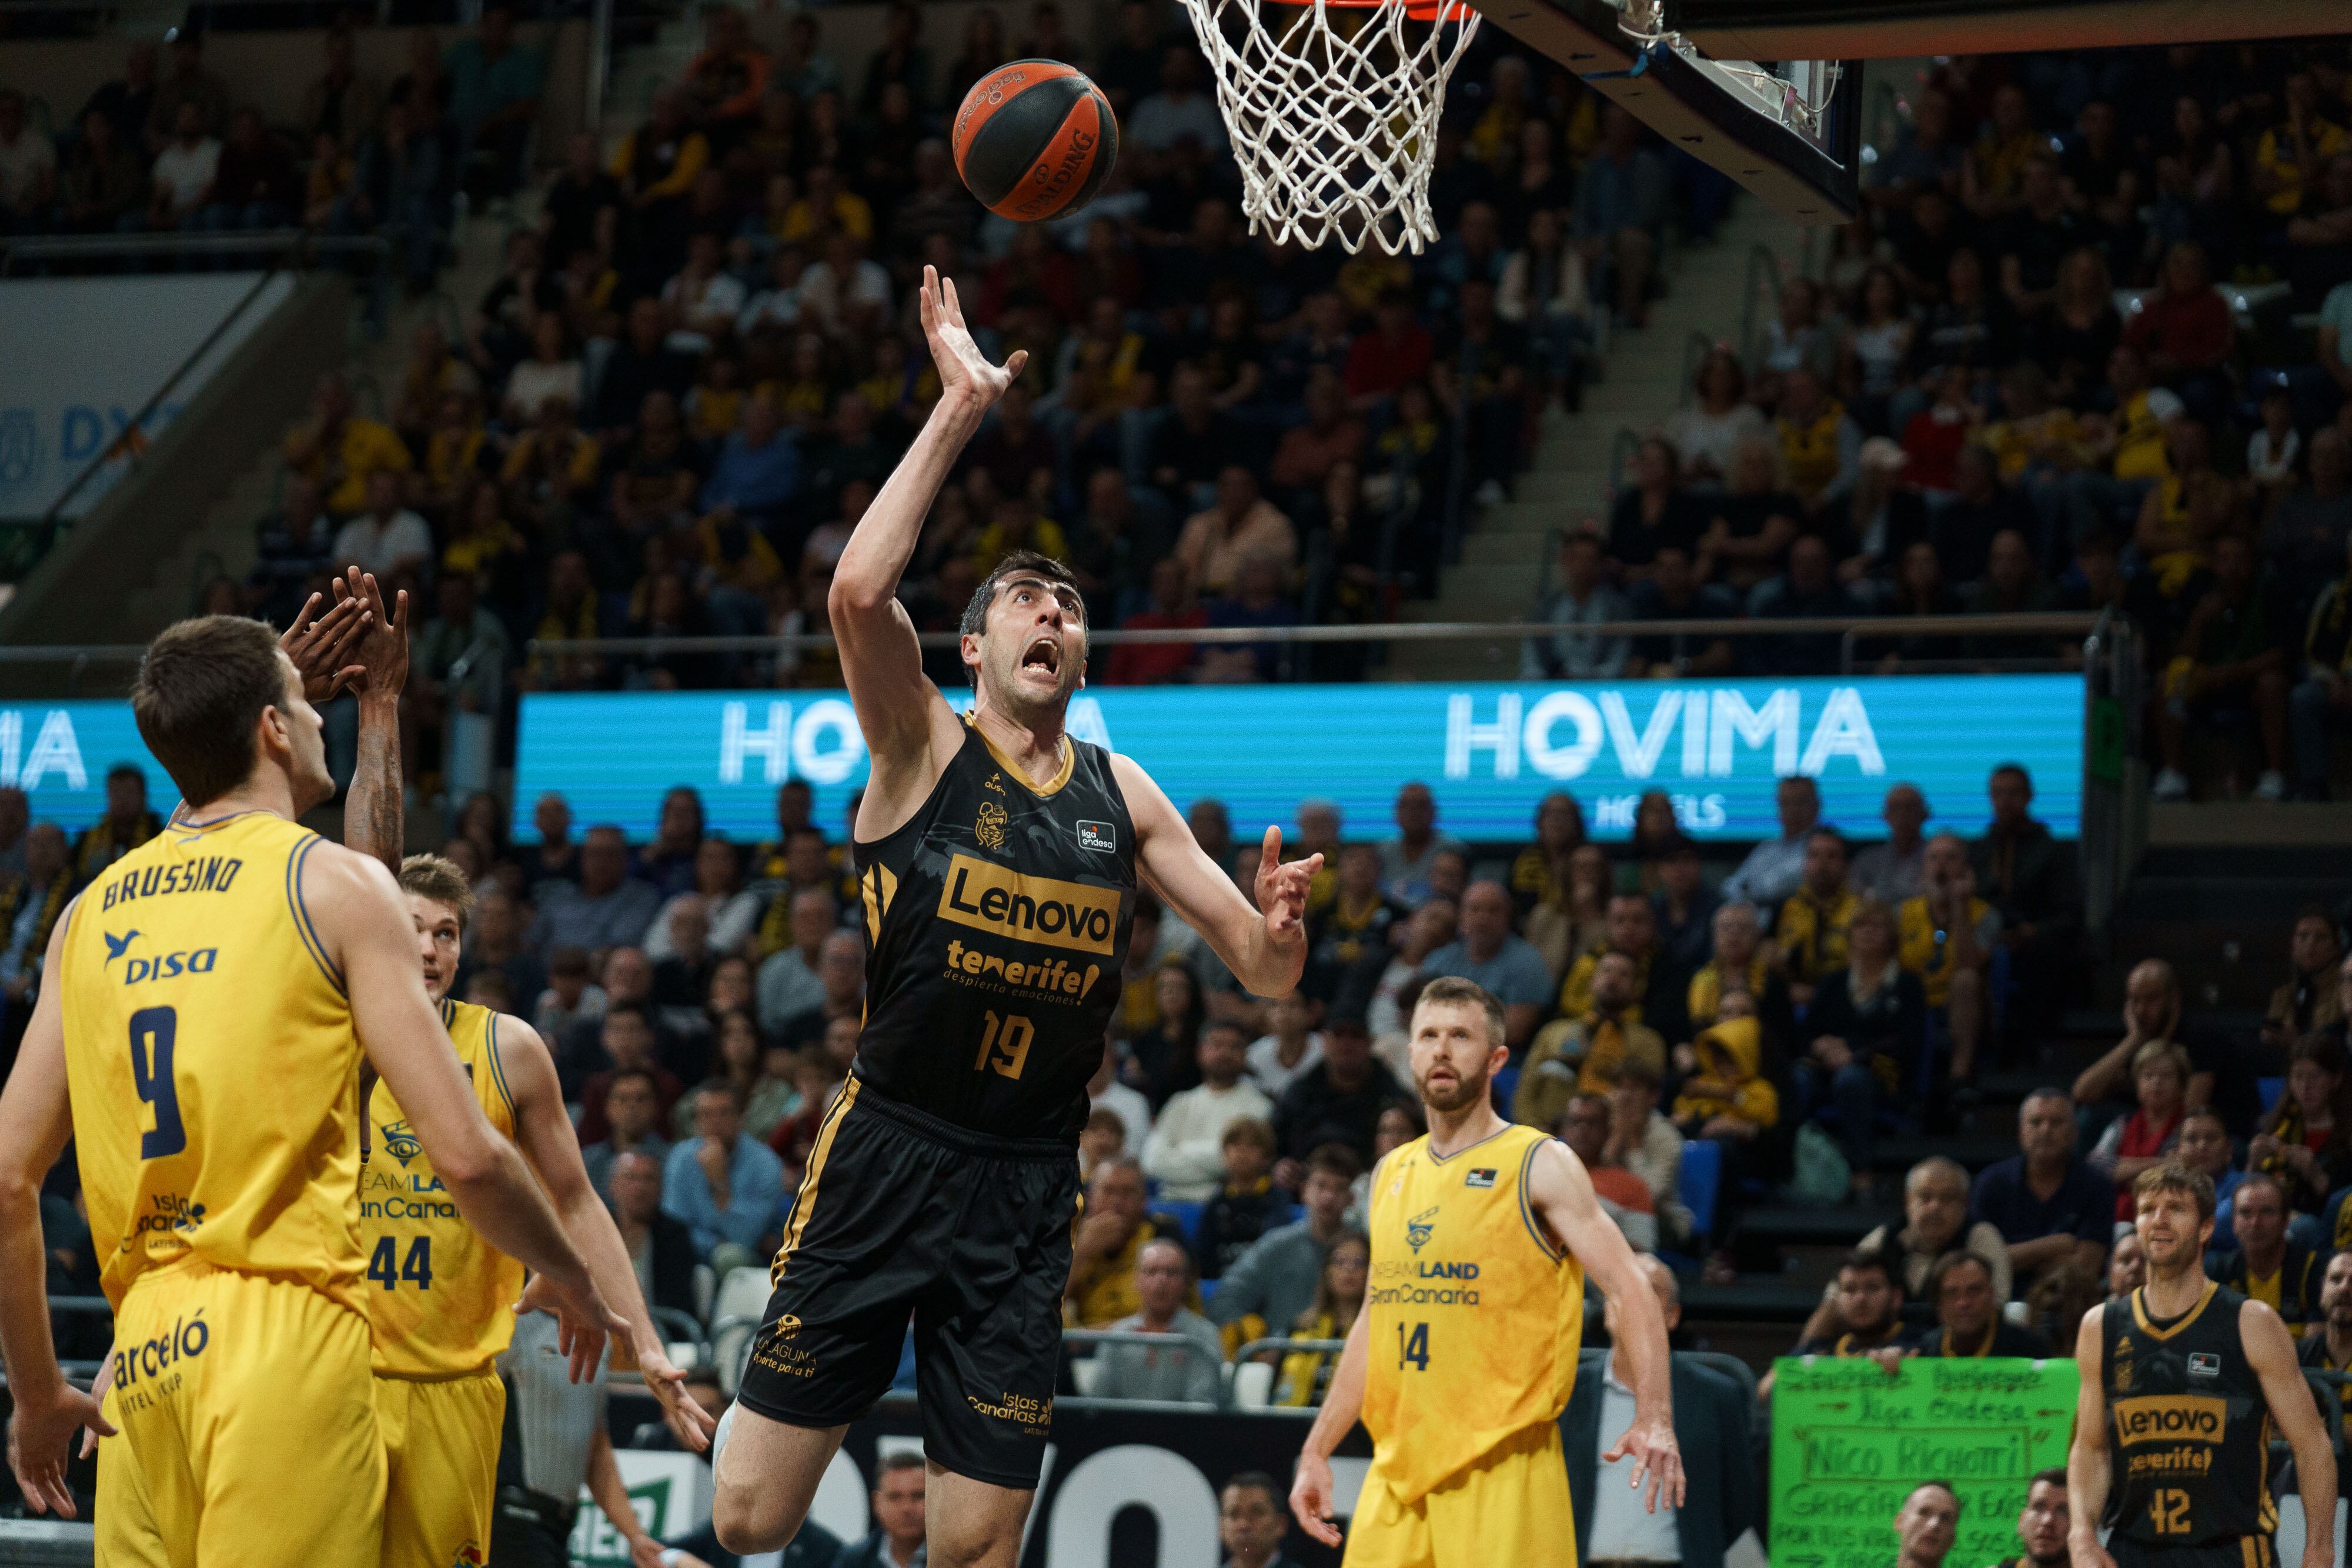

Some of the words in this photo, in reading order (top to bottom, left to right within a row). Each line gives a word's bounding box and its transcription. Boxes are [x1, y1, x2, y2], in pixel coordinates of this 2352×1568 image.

[1444, 687, 1886, 780] HOVIMA
[1081, 828, 1097, 839] liga
[1083, 838, 1112, 849] endesa
[102, 856, 243, 912] BRUSSINO
[949, 867, 1111, 942] Lenovo
[943, 969, 1006, 994] despierta
[1011, 989, 1074, 1006] emociones
[947, 940, 1100, 1006] tenerife!
[974, 1009, 1035, 1081] 19
[128, 1004, 187, 1161] 9
[367, 1235, 433, 1290] 44
[113, 1308, 209, 1390] arceló
[1397, 1322, 1430, 1372] 14
[967, 1396, 1037, 1424] Canarias
[1002, 1392, 1039, 1410] Islas
[2120, 1409, 2219, 1437] Lenovo
[2149, 1487, 2192, 1534] 42
